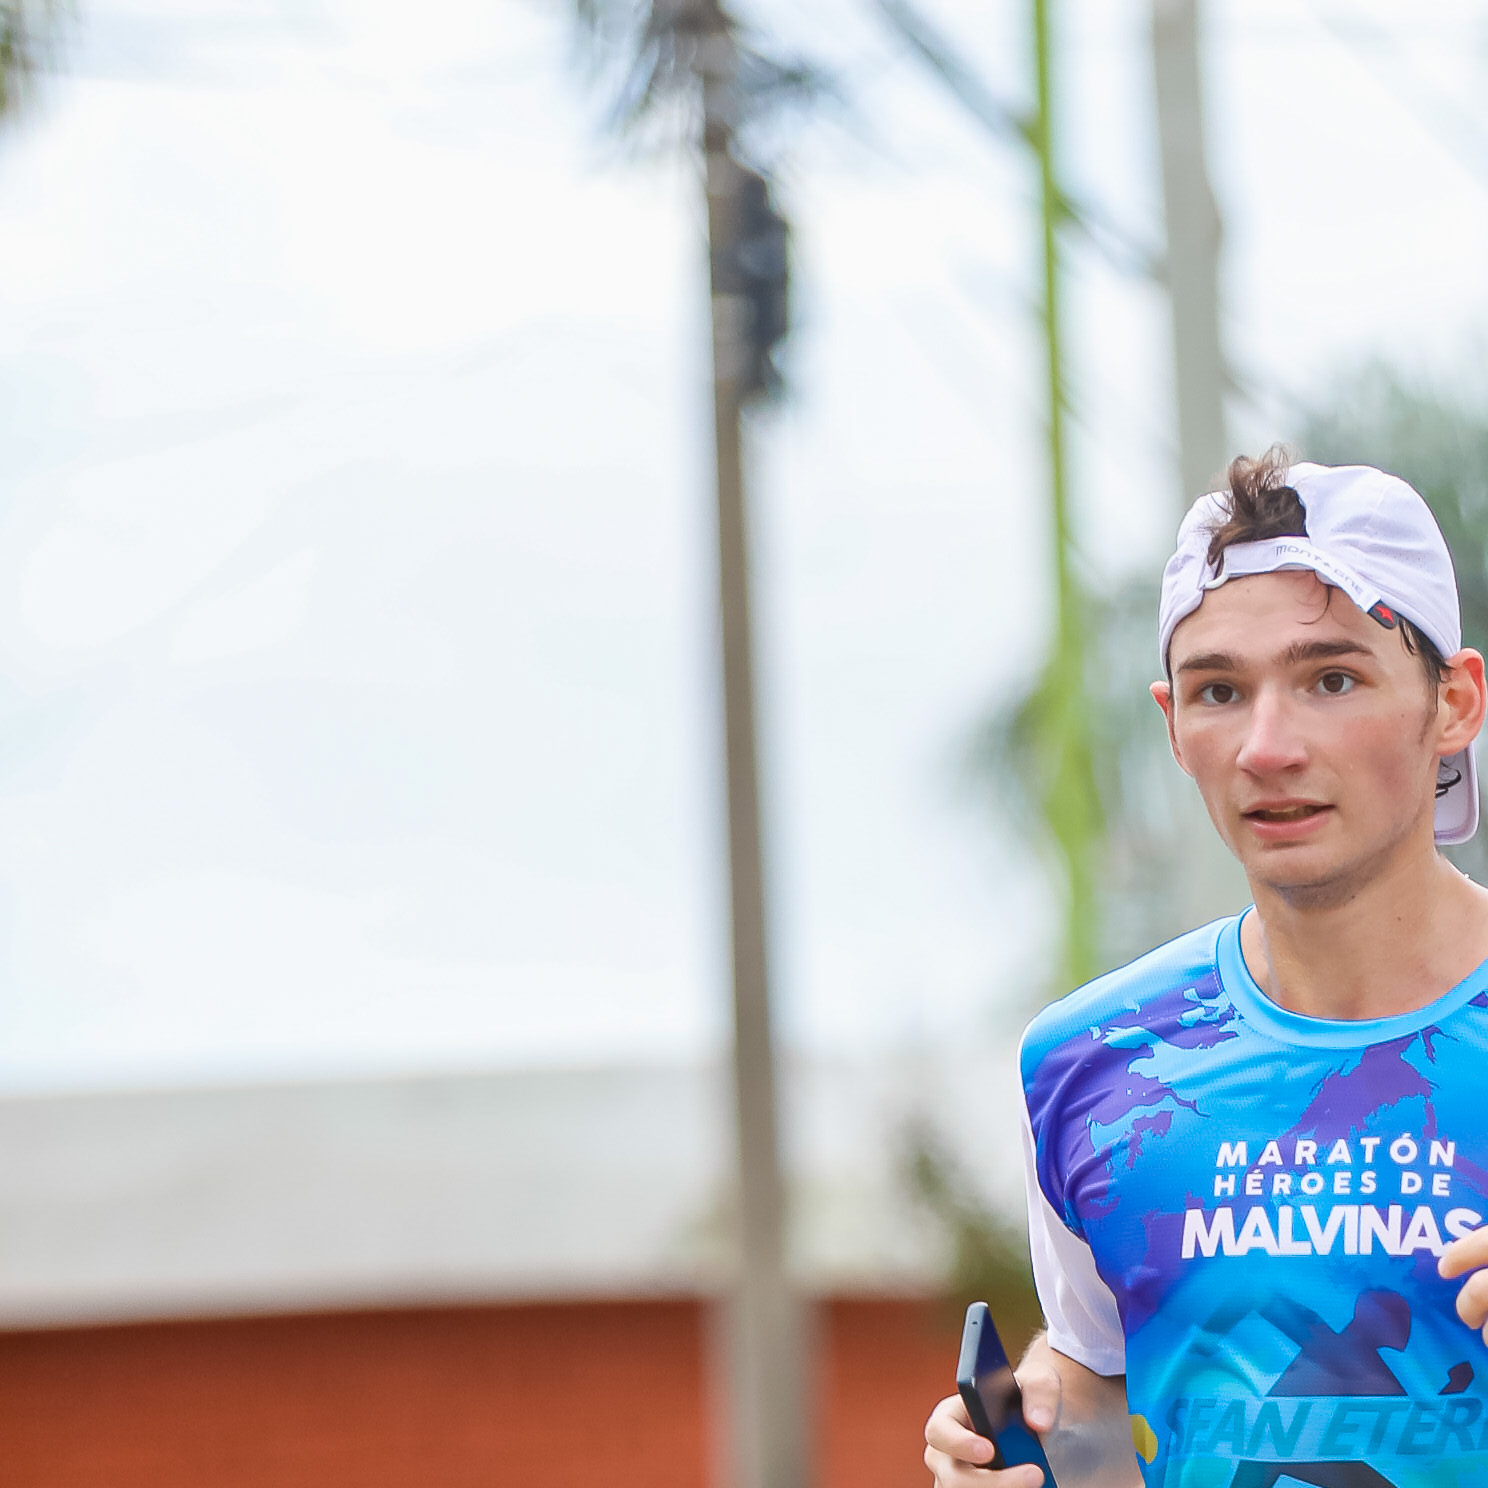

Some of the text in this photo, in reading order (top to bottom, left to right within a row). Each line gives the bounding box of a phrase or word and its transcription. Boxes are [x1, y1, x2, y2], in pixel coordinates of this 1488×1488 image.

[1216, 1134, 1456, 1167] MARATÓN
[1213, 1170, 1452, 1197] HÉROES DE
[1181, 1205, 1484, 1259] MALVINAS
